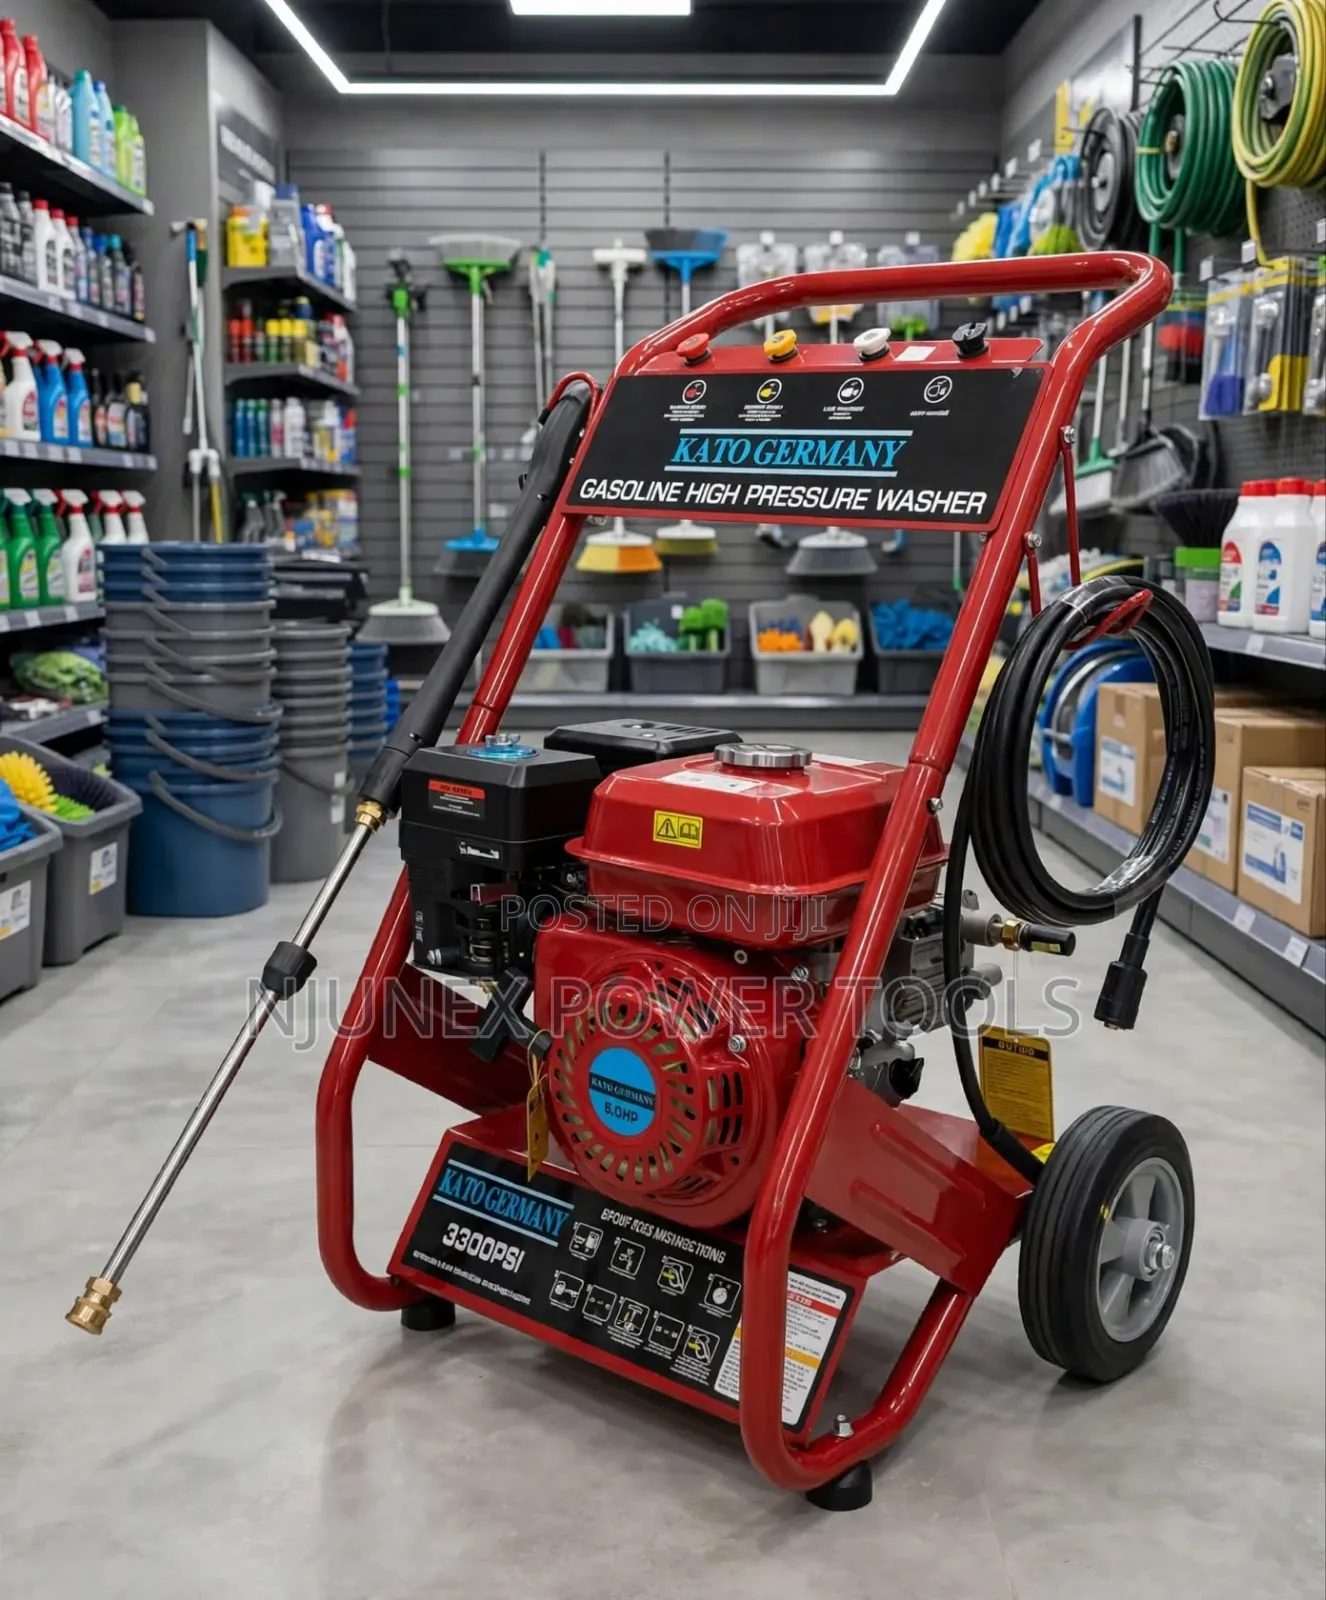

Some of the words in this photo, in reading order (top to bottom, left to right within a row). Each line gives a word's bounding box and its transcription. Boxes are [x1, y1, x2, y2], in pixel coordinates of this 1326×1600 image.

[670, 437, 752, 464] KATO
[752, 438, 908, 468] GERMANY
[579, 477, 685, 503] GASOLINE
[684, 481, 742, 506] HIGH
[743, 484, 872, 511] PRESSURE
[875, 488, 988, 516] WASHER
[604, 1101, 639, 1124] 5.0HP
[438, 1167, 487, 1205] KATO
[484, 1186, 570, 1237] GERMANY
[442, 1222, 526, 1273] 3300PSI
